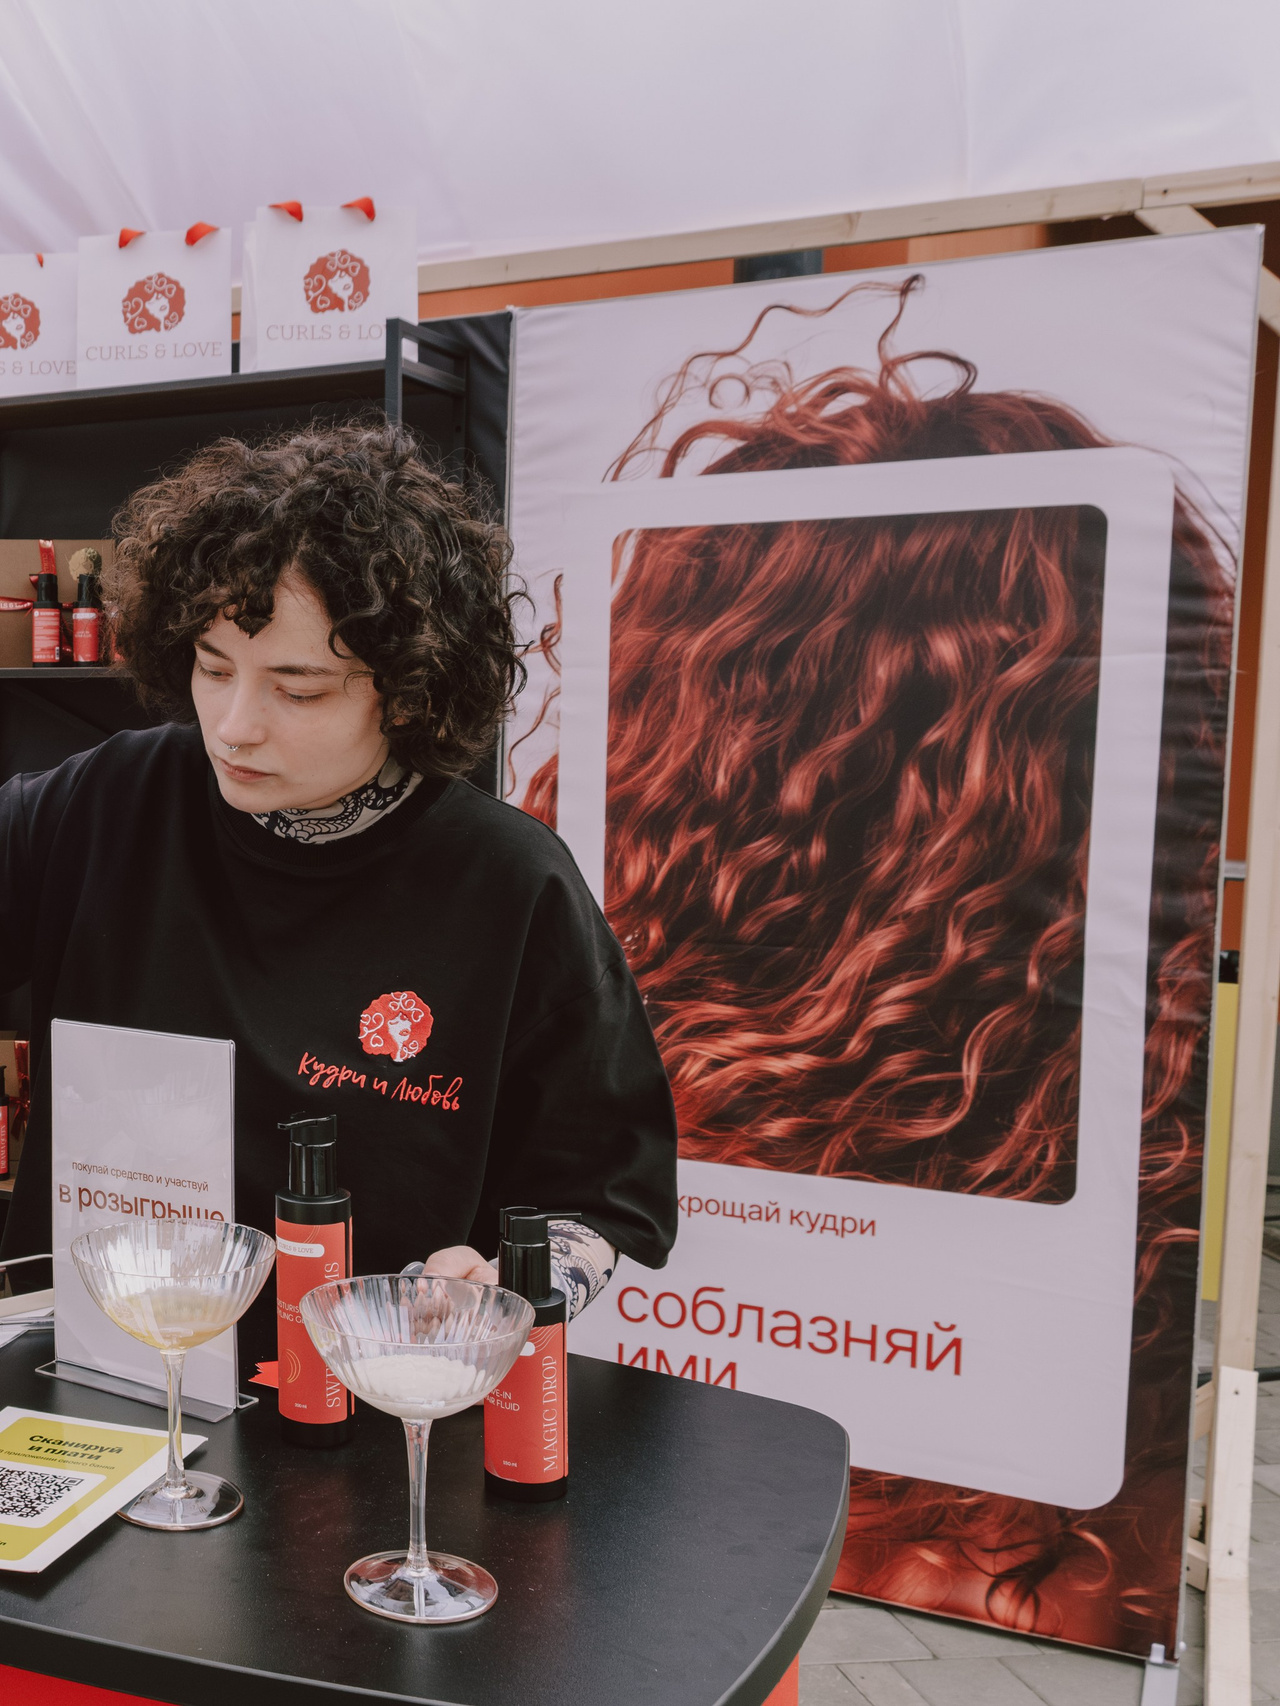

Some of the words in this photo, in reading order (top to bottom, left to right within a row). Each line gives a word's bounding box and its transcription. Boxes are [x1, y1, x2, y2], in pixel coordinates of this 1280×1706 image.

[265, 323, 333, 341] CURLS
[338, 323, 352, 340] &
[85, 344, 149, 361] CURLS
[154, 343, 167, 359] &
[173, 341, 224, 358] LOVE
[11, 360, 24, 375] &
[29, 360, 77, 376] LOVE
[297, 1051, 367, 1089] Кудри
[372, 1077, 388, 1095] и
[390, 1074, 463, 1111] Любовь
[71, 1161, 109, 1175] покупай
[110, 1167, 154, 1183] средство
[155, 1175, 163, 1184] и
[164, 1177, 209, 1193] участвуй
[789, 1208, 877, 1238] кудри
[297, 1246, 314, 1254] LOVE
[616, 1286, 963, 1377] соблазняй
[541, 1355, 558, 1404] DROP
[496, 1399, 520, 1412] FLUID
[28, 1435, 123, 1454] Сканируй
[542, 1408, 558, 1473] MAGIC
[43, 1447, 102, 1461] плати
[58, 1459, 88, 1467] своего
[88, 1462, 116, 1470] банка
